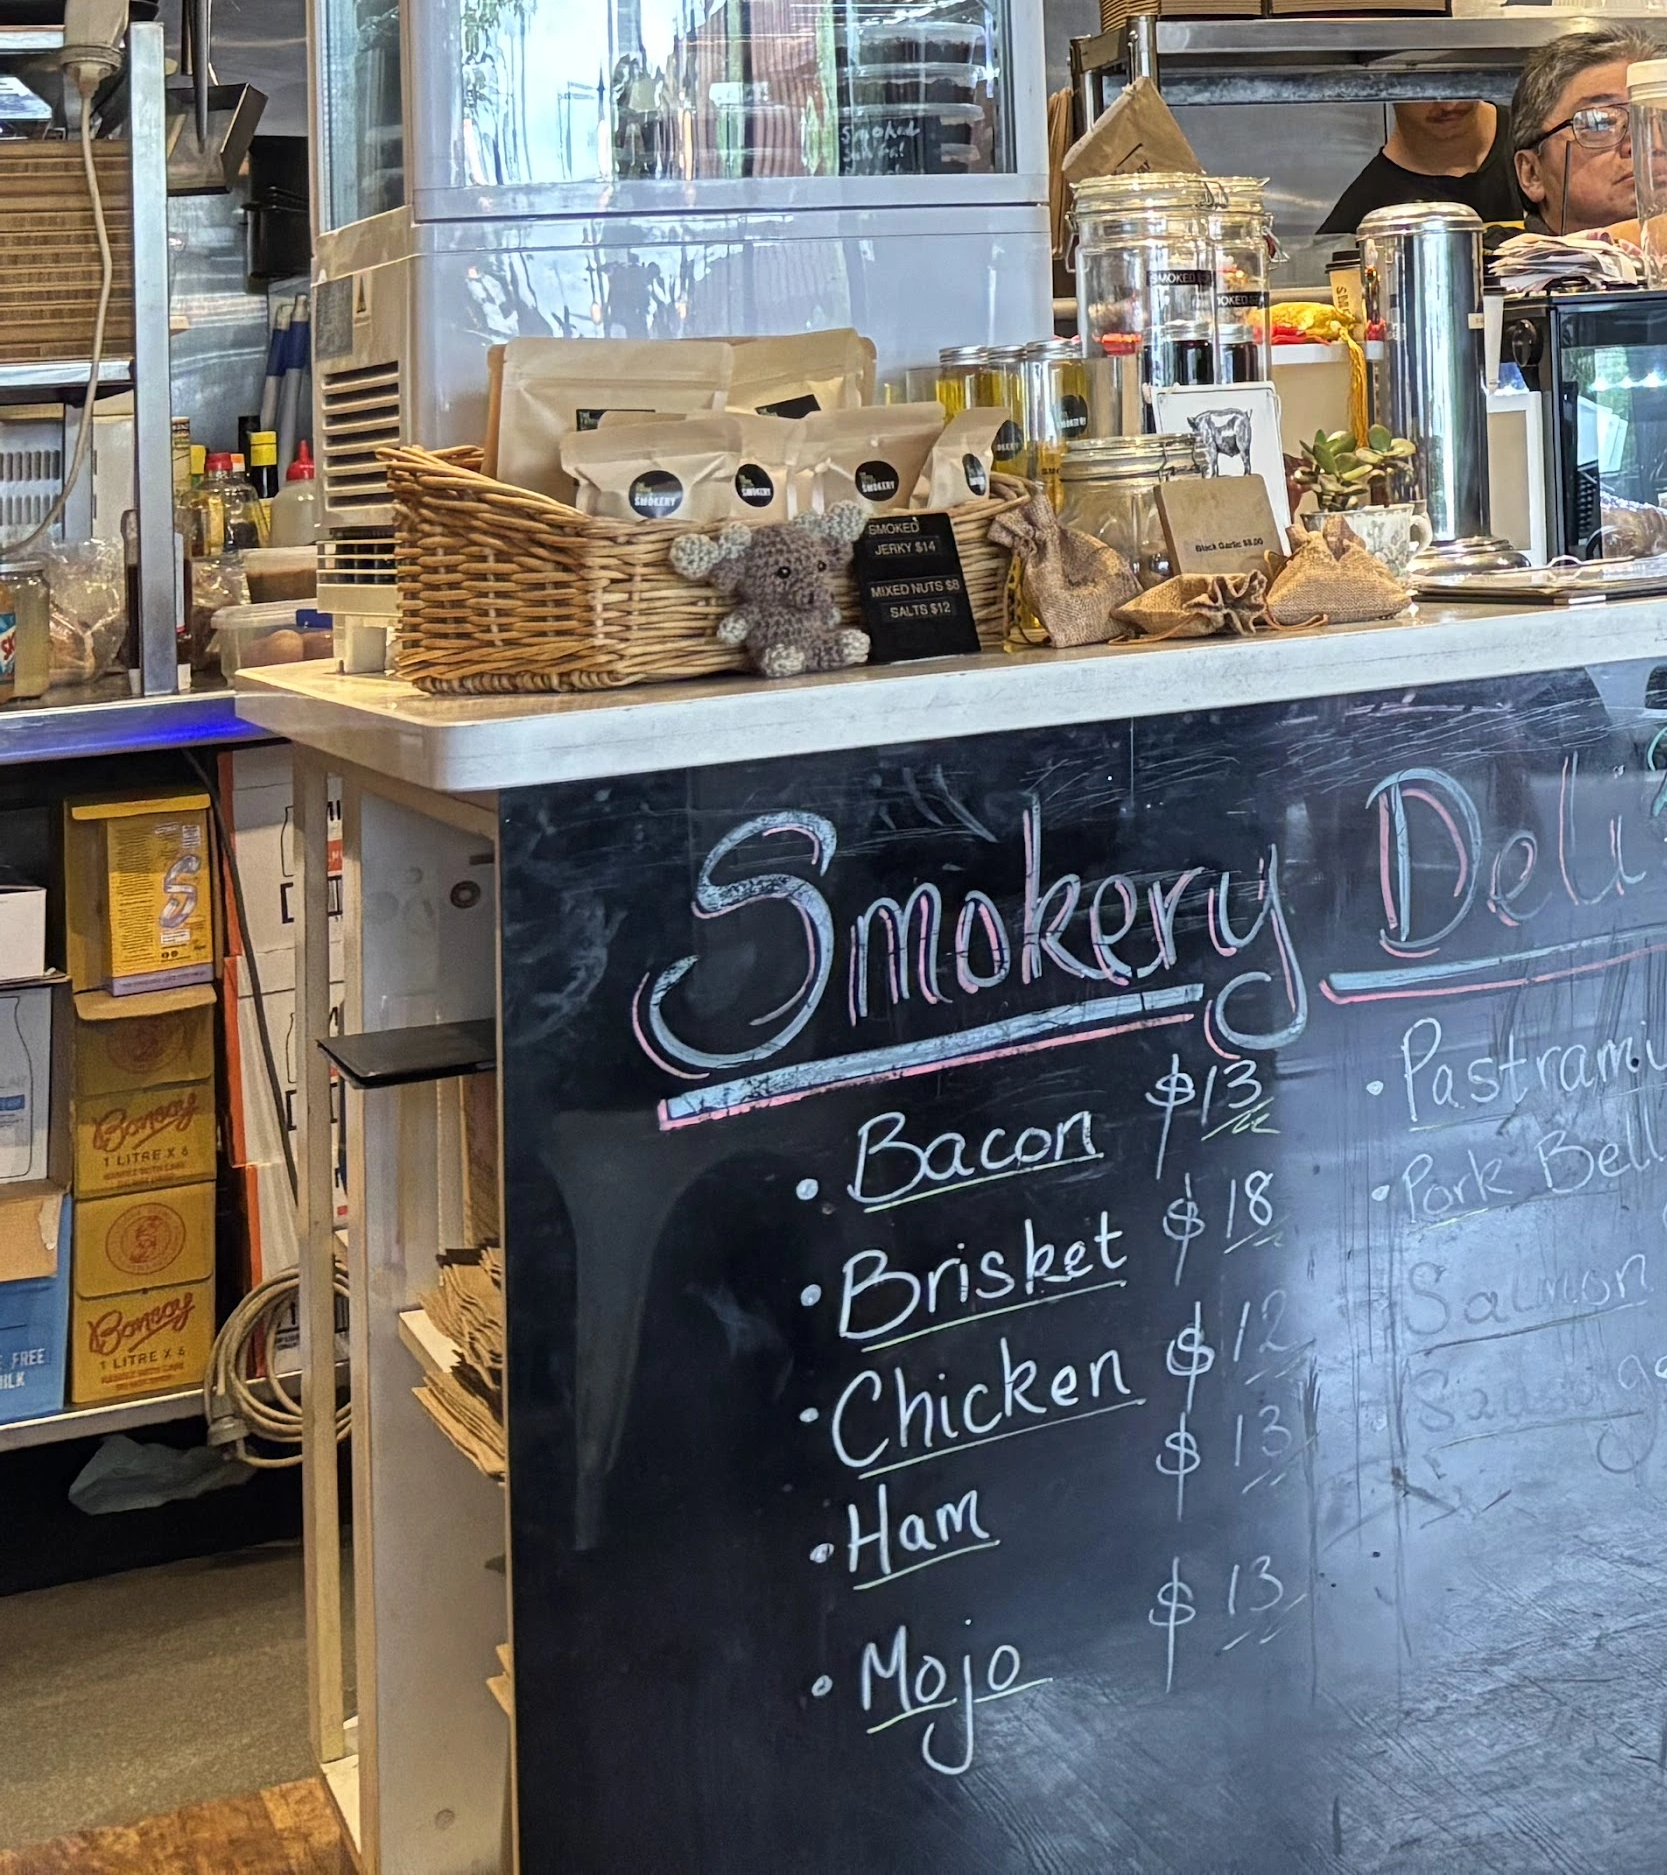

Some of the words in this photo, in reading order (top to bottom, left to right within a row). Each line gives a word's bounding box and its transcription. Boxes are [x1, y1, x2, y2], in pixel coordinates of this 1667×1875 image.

[861, 481, 896, 494] SMOKERY
[634, 496, 676, 507] SMOKERY
[868, 522, 920, 537] SMOKED
[874, 543, 912, 557] JERKY
[914, 540, 937, 554] $14
[870, 583, 910, 599] MIXED
[910, 580, 944, 597] NUTS
[889, 603, 929, 619] SALTS
[930, 600, 952, 616] $12
[632, 792, 1308, 1079] Smokery
[1366, 751, 1647, 959] Deli
[847, 1110, 1099, 1204] Bacon
[1146, 1053, 1264, 1180] $13
[117, 1149, 162, 1166] LITRE
[1401, 1150, 1513, 1223] Pork
[839, 1210, 1129, 1340] Brisket
[1404, 1254, 1656, 1337] Salmon
[11, 1348, 46, 1366] FREE
[112, 1350, 158, 1369] LITRE
[832, 1337, 1132, 1468] Chicken
[848, 1483, 991, 1575] Ham
[862, 1619, 1022, 1775] Mojo
